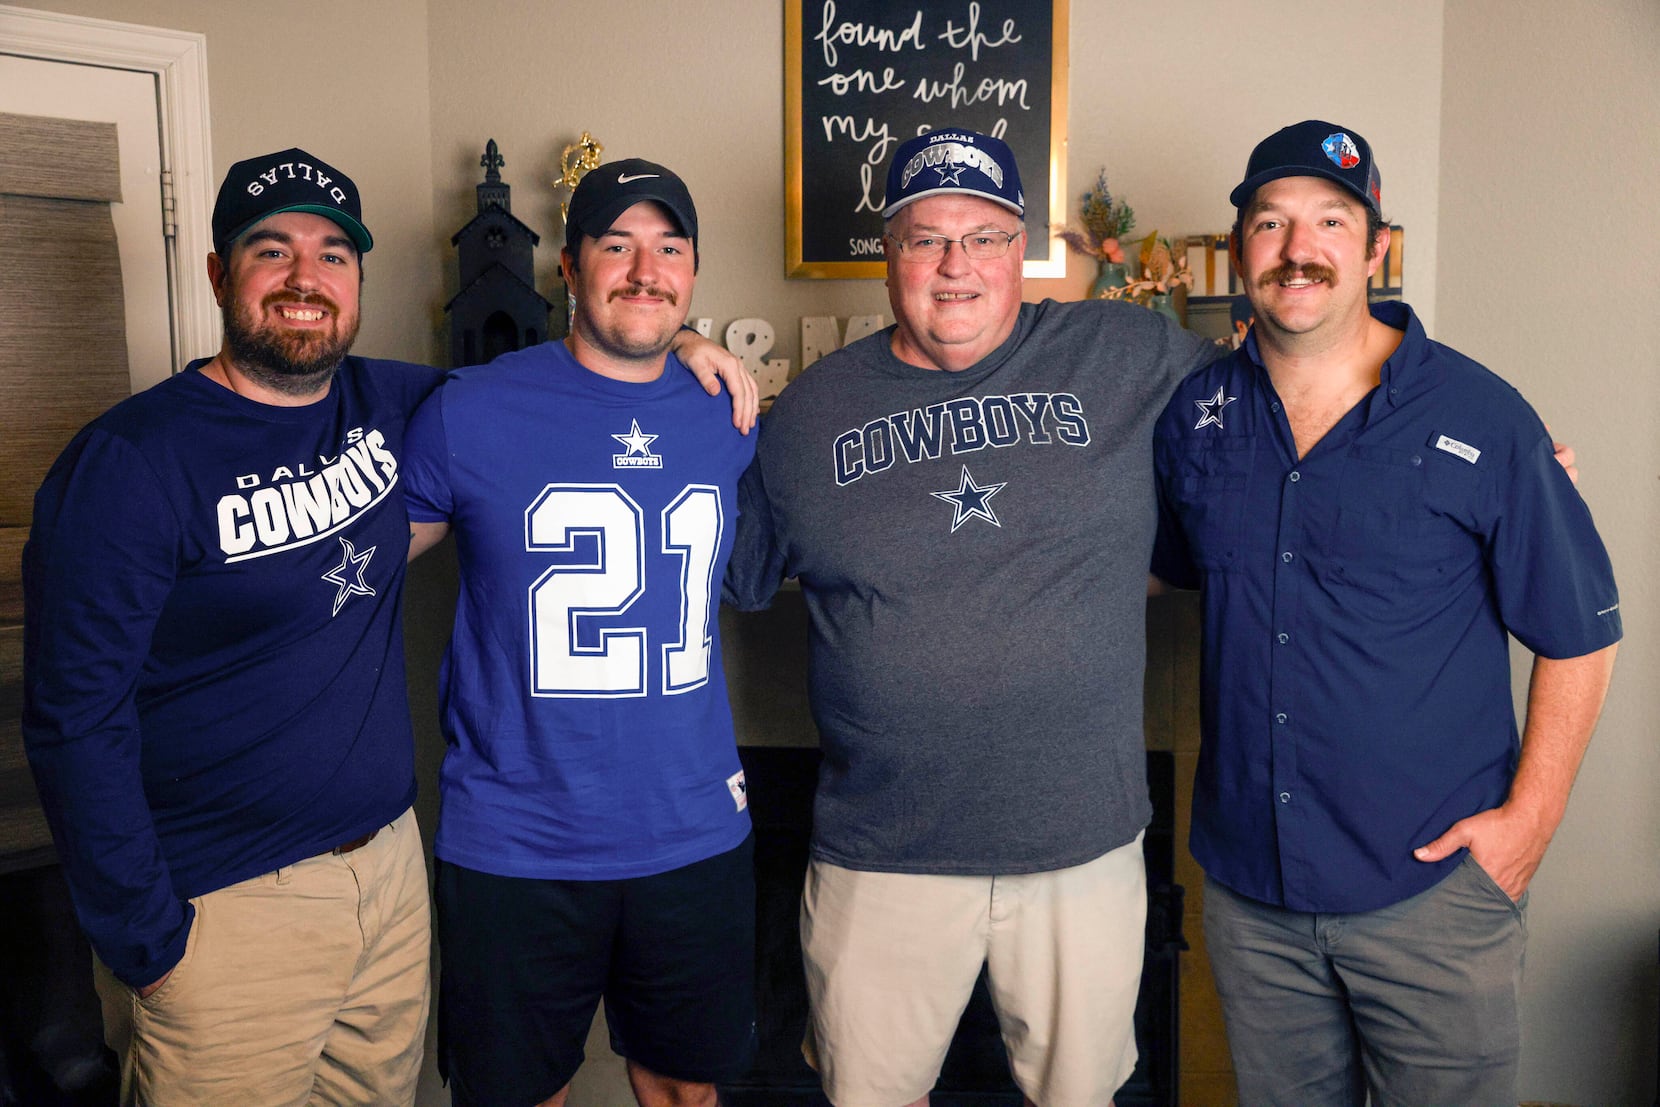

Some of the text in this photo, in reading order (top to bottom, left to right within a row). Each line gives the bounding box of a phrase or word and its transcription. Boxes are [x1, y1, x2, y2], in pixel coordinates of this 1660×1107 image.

[814, 0, 1022, 67] found the
[818, 62, 1030, 110] one whom
[822, 115, 897, 164] my
[929, 133, 974, 143] DALLAS
[247, 162, 346, 204] DALLAS
[902, 142, 1003, 189] COWBOYS
[236, 427, 363, 489] DALLS
[616, 456, 659, 466] COWBOYS
[832, 392, 1091, 486] COWBOYS
[217, 429, 397, 555] COWBOYS
[524, 482, 723, 698] 21
